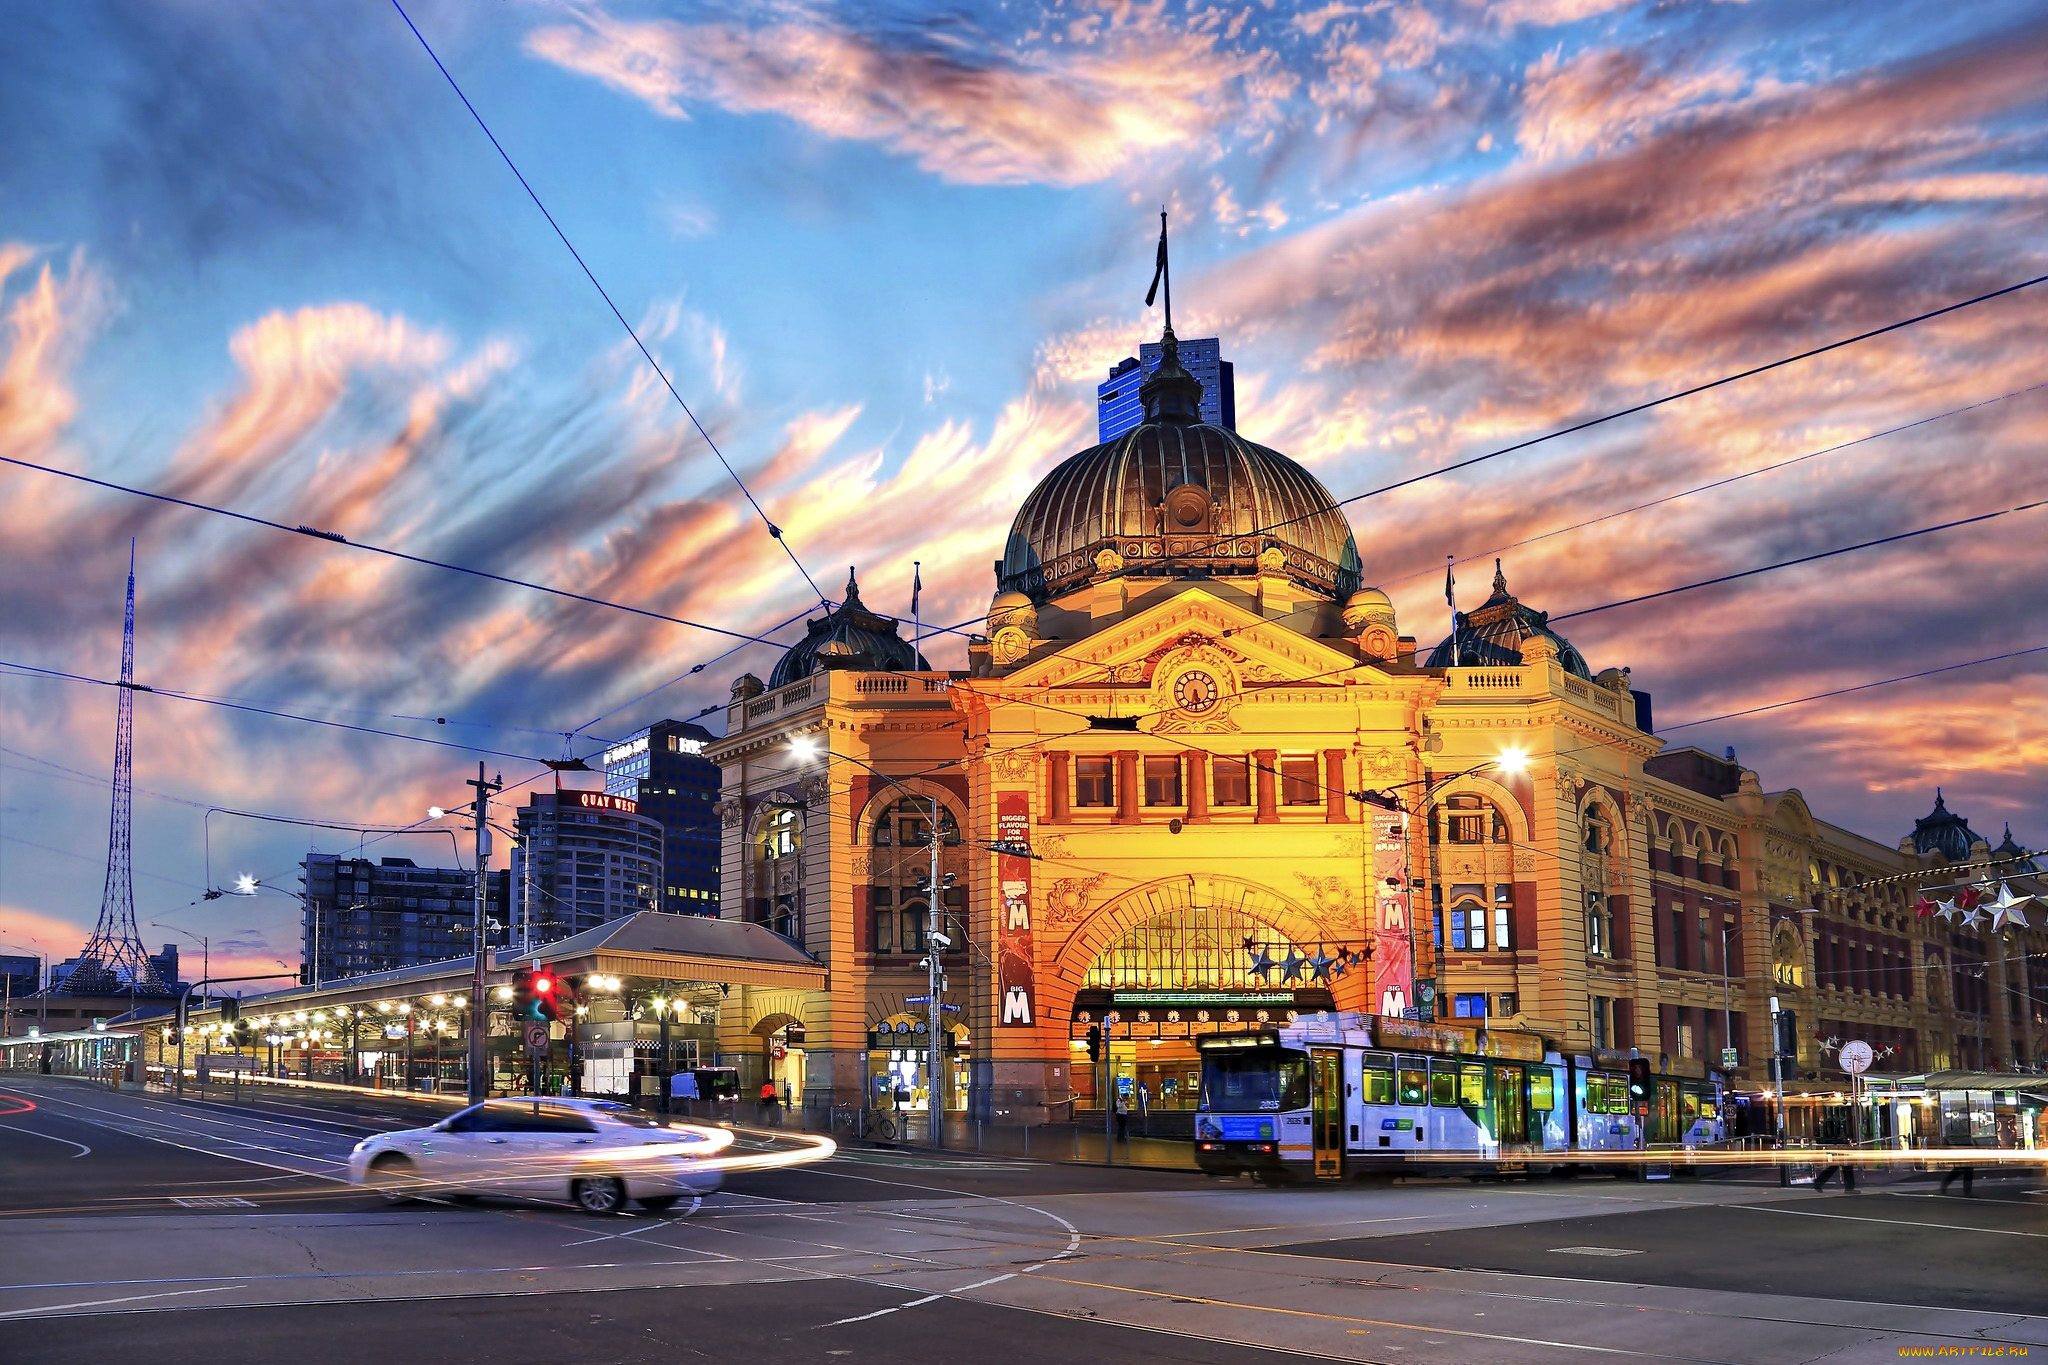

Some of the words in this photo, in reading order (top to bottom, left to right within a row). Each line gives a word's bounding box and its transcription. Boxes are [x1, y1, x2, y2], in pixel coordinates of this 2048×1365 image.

[581, 793, 610, 808] QUAY
[614, 799, 636, 814] WEST
[1008, 905, 1030, 930] M
[1385, 904, 1405, 930] M
[1003, 992, 1031, 1024] M
[1382, 992, 1406, 1018] M
